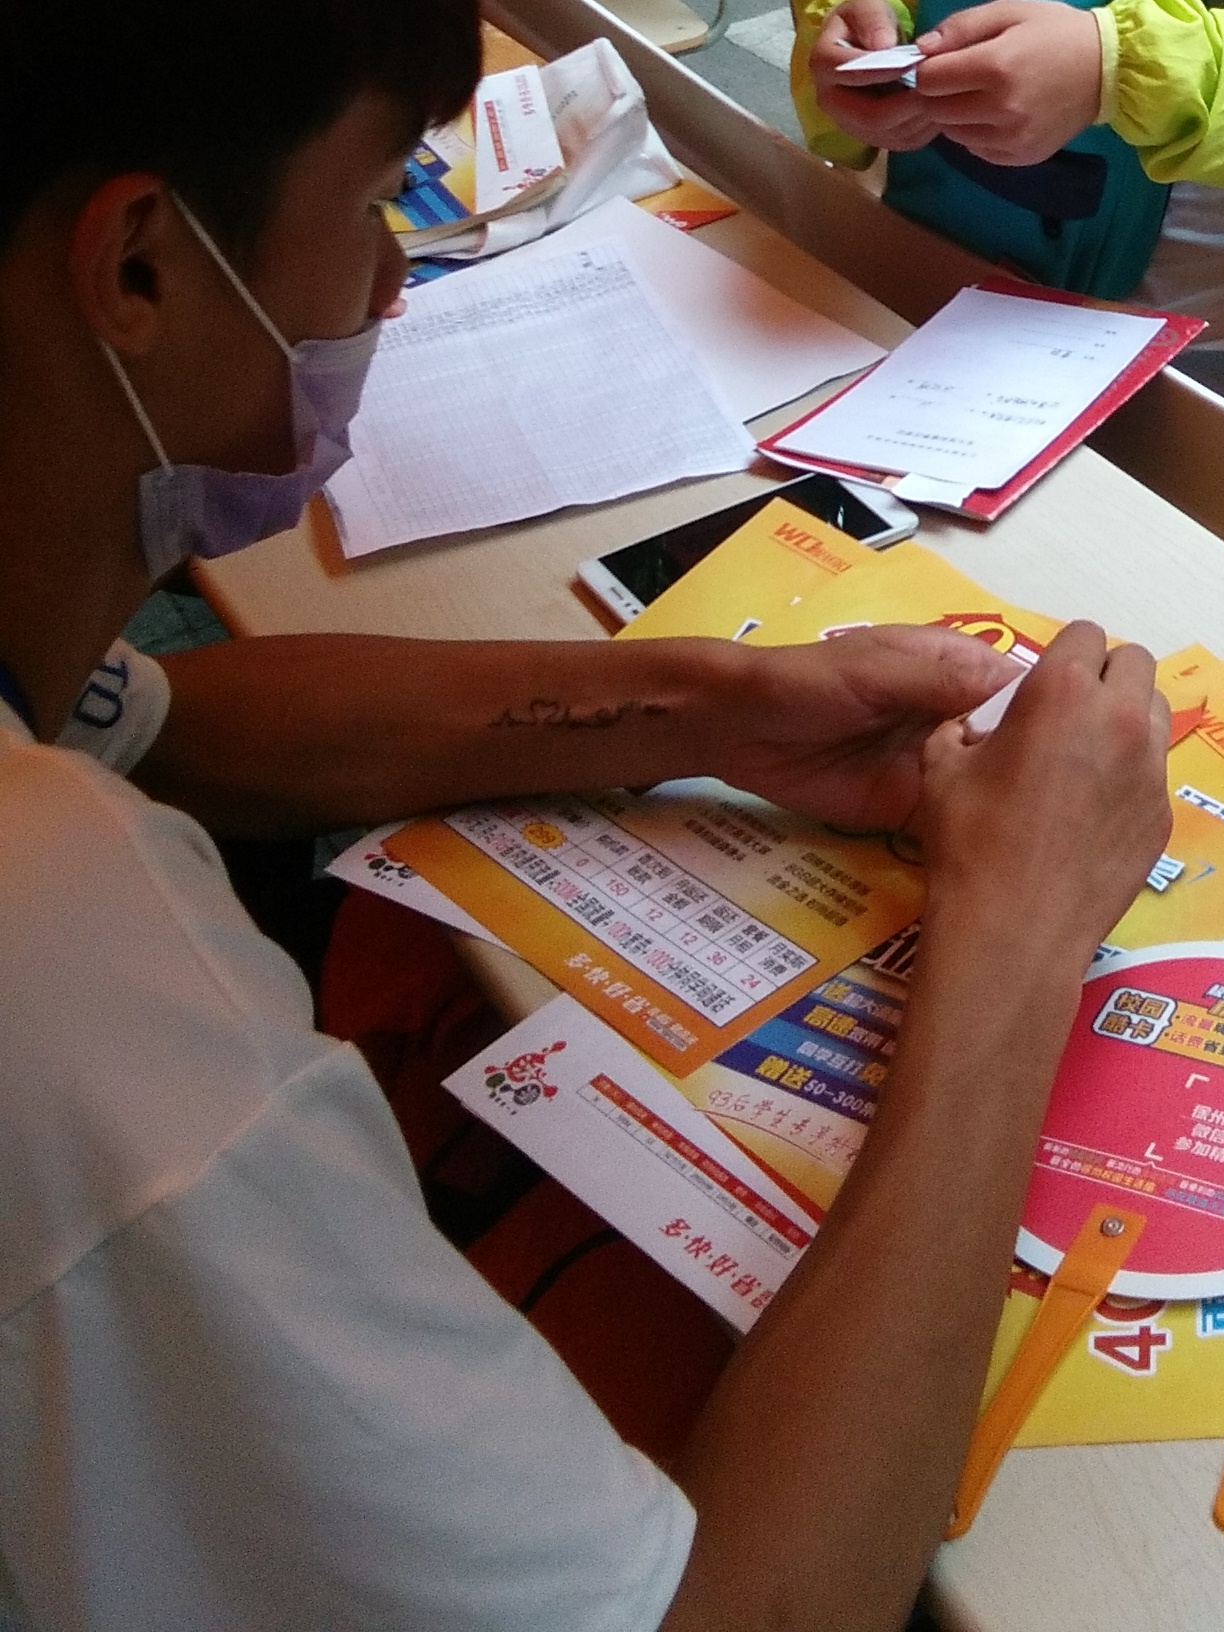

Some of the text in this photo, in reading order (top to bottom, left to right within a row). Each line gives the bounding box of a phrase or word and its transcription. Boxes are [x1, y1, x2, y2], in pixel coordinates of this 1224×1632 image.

[740, 973, 762, 990] 24
[1114, 990, 1169, 1019] 校园
[1099, 1012, 1155, 1040] 酷卡
